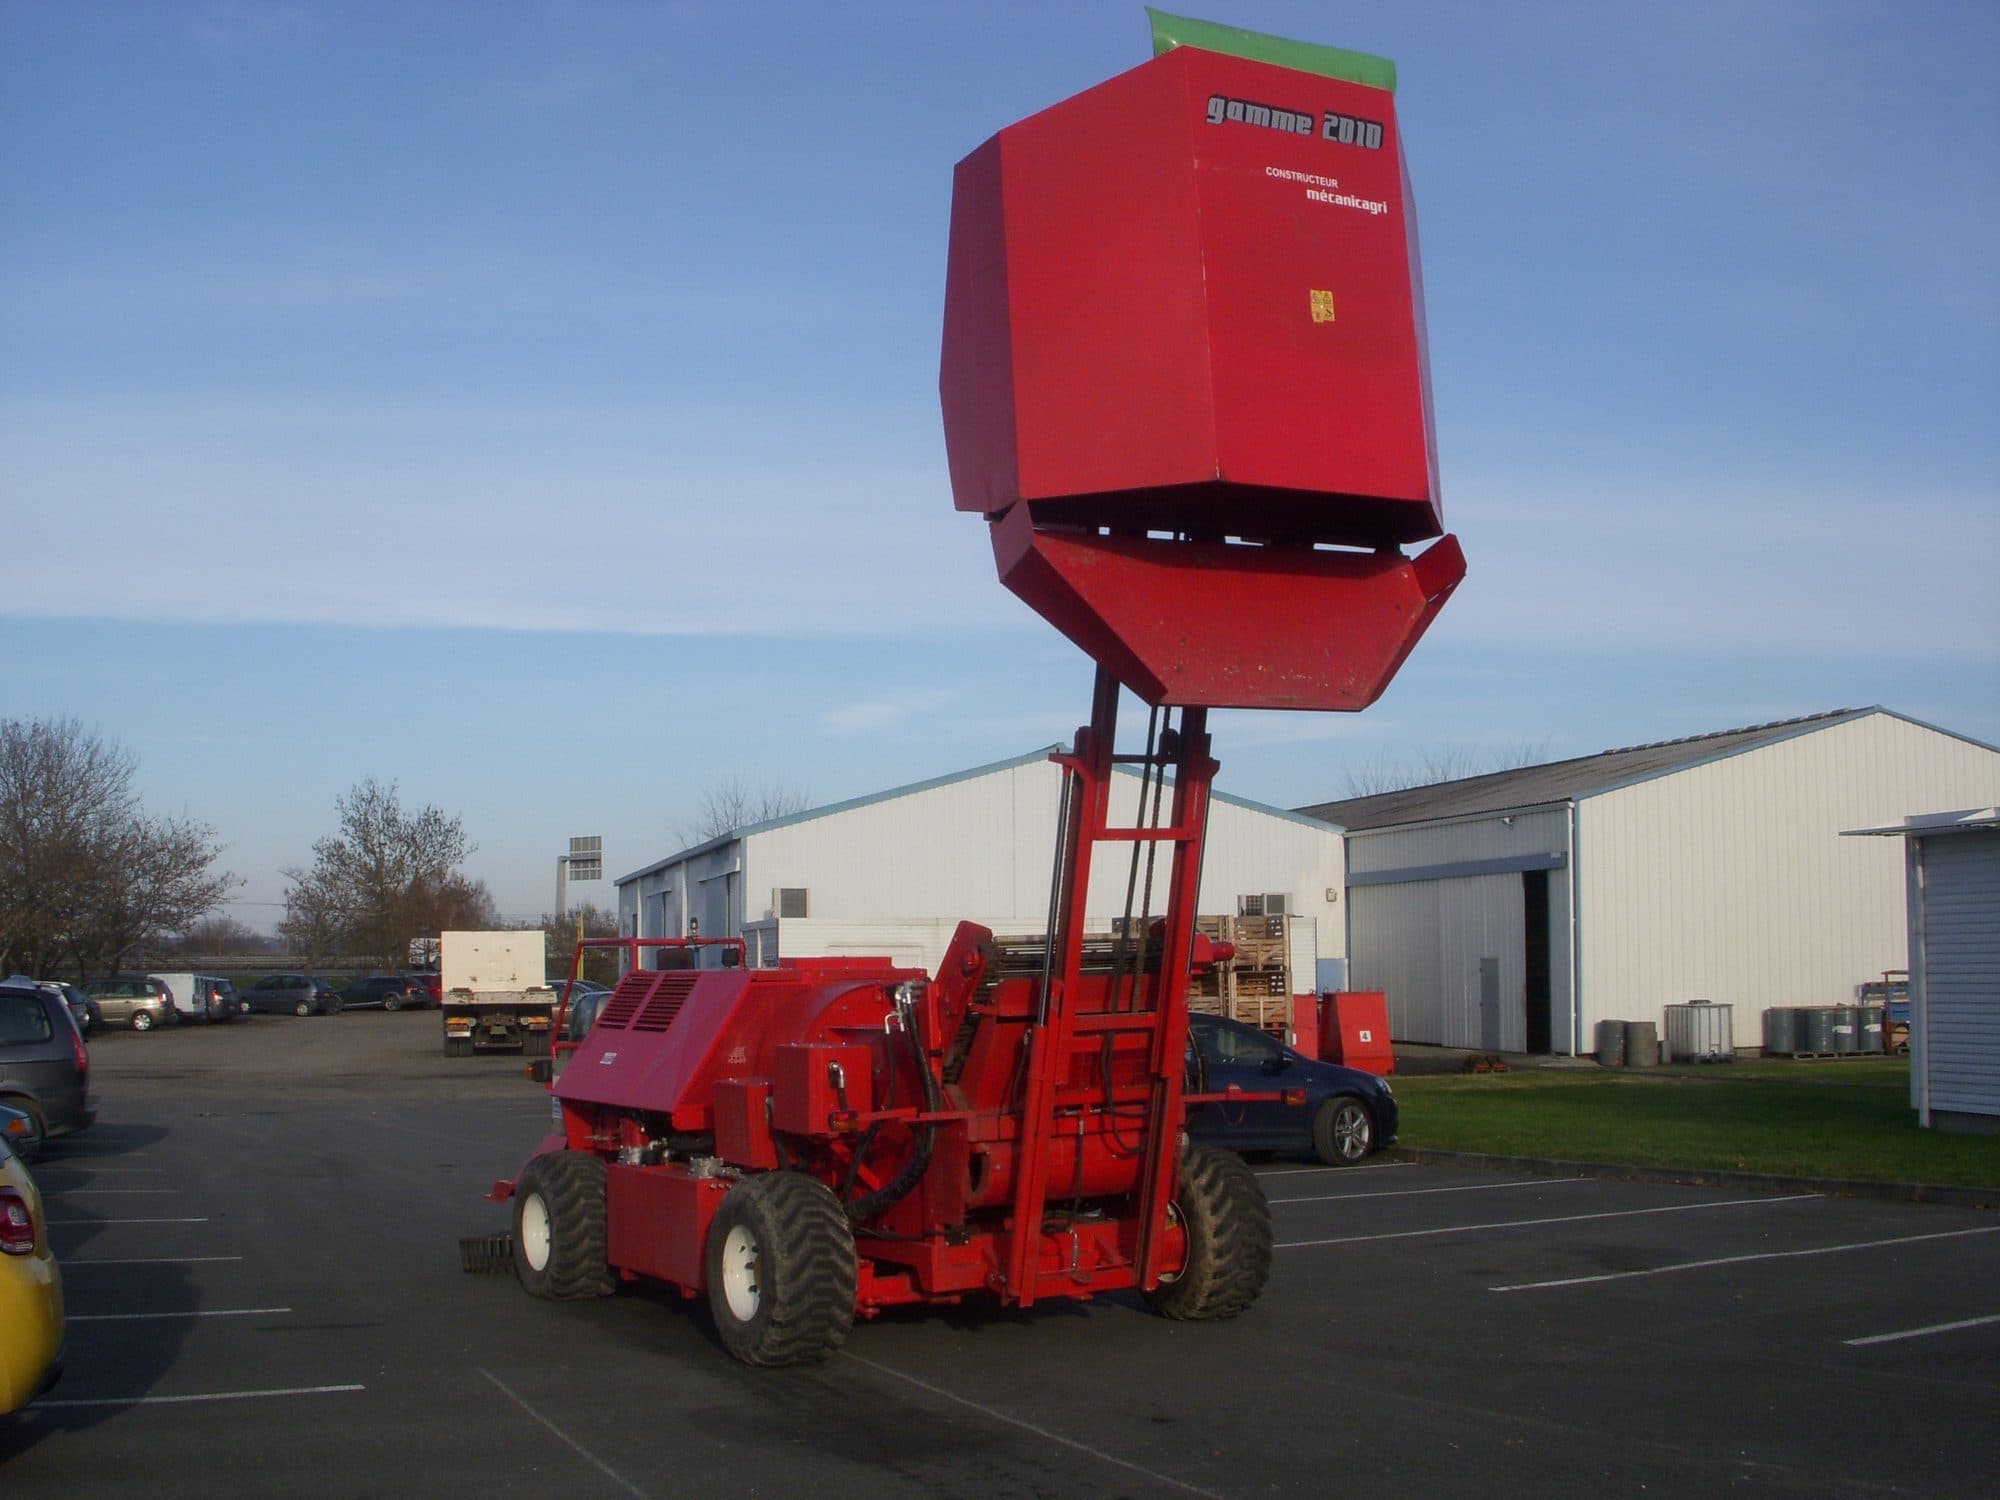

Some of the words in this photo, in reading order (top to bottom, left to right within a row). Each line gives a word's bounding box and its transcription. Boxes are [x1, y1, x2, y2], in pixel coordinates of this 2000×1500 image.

[1206, 95, 1314, 136] gamme
[1321, 112, 1384, 150] 2010
[1266, 166, 1338, 188] CONSTRUCTEUR
[1306, 188, 1388, 215] mécanicagri
